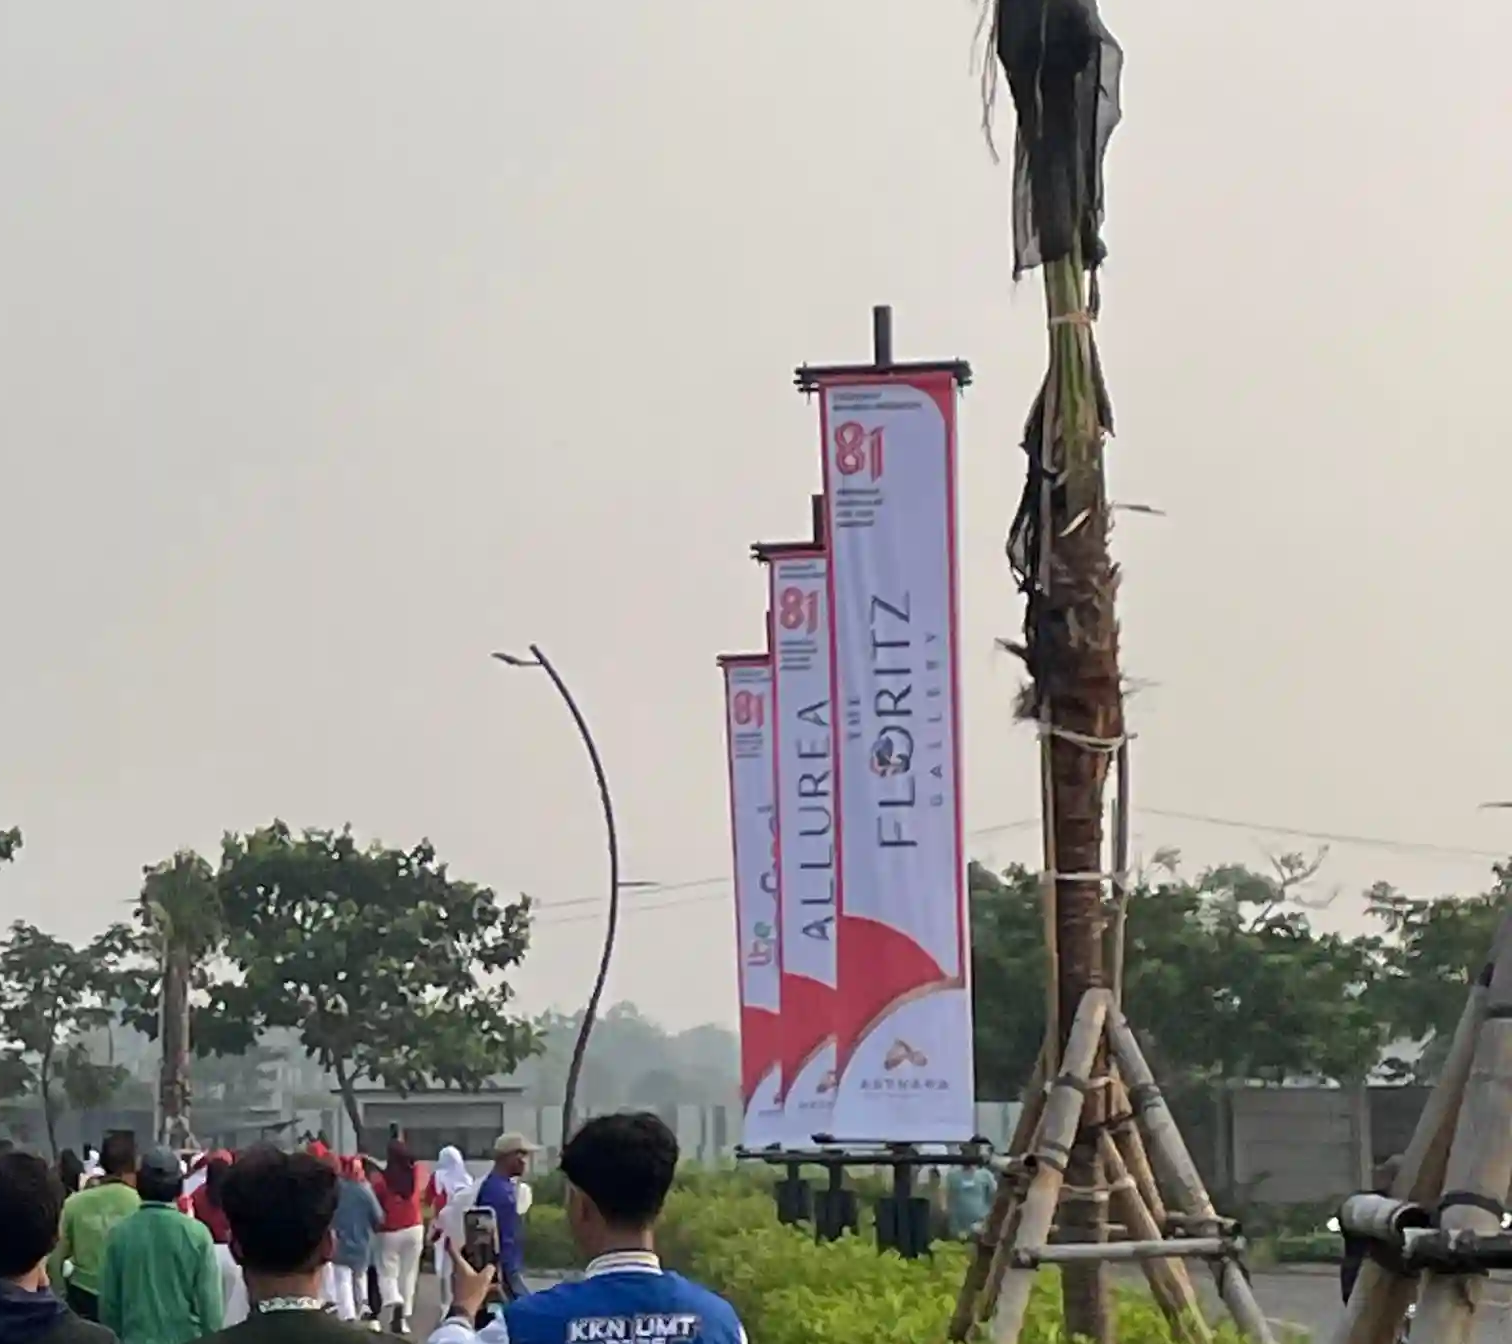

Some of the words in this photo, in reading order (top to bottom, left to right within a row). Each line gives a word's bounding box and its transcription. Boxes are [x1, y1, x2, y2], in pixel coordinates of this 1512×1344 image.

[834, 420, 885, 484] 81
[779, 586, 819, 635] 81
[869, 590, 919, 848] FLORITZ
[796, 699, 835, 942] ALLUREA
[569, 1318, 626, 1342] KKN
[635, 1316, 697, 1337] UMT
